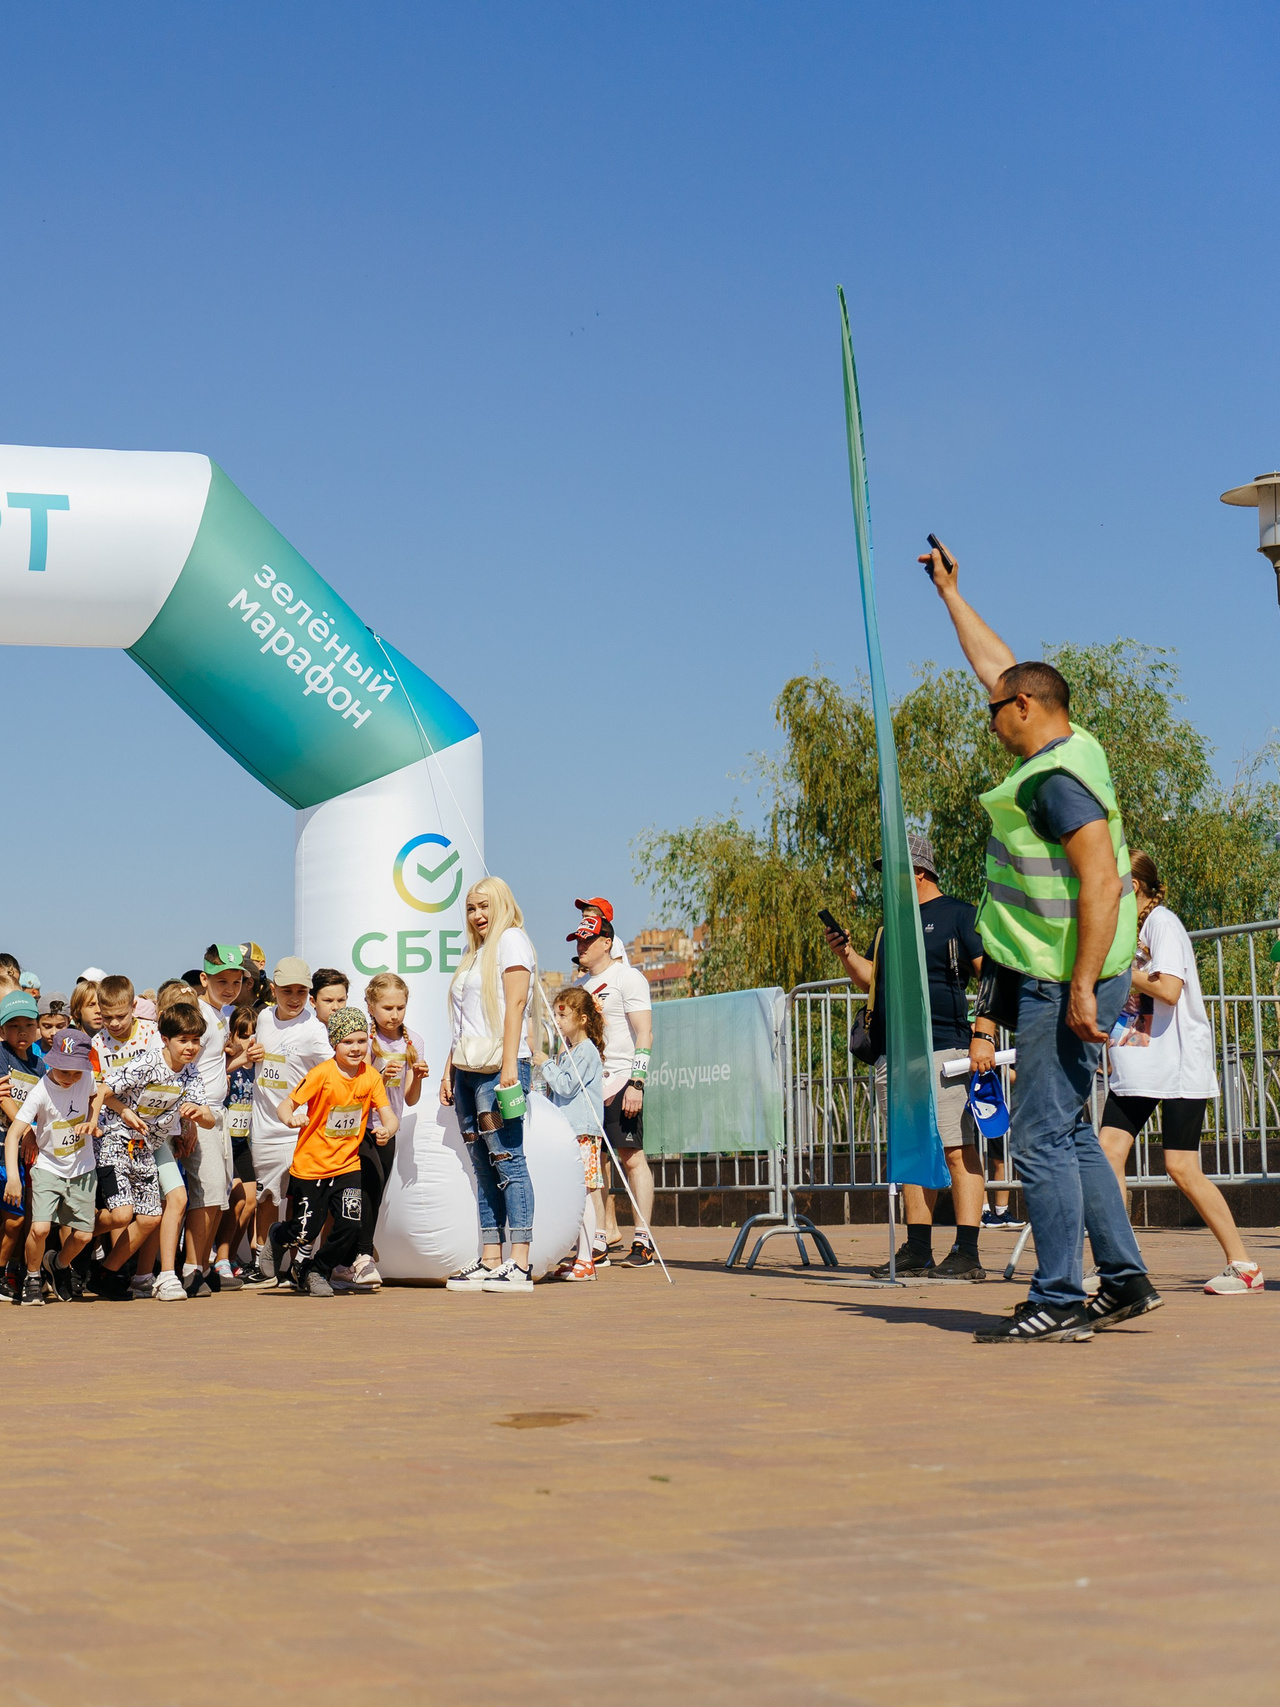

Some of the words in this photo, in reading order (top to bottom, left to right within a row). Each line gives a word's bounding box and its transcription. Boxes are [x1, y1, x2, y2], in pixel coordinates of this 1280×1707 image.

[253, 564, 396, 703] зелёный
[227, 588, 373, 729] марафон
[351, 930, 463, 976] СБЕ
[264, 1068, 280, 1080] 306
[643, 1061, 731, 1091] аябудущее
[147, 1098, 169, 1108] 221
[232, 1117, 248, 1128] 215
[335, 1118, 355, 1129] 419
